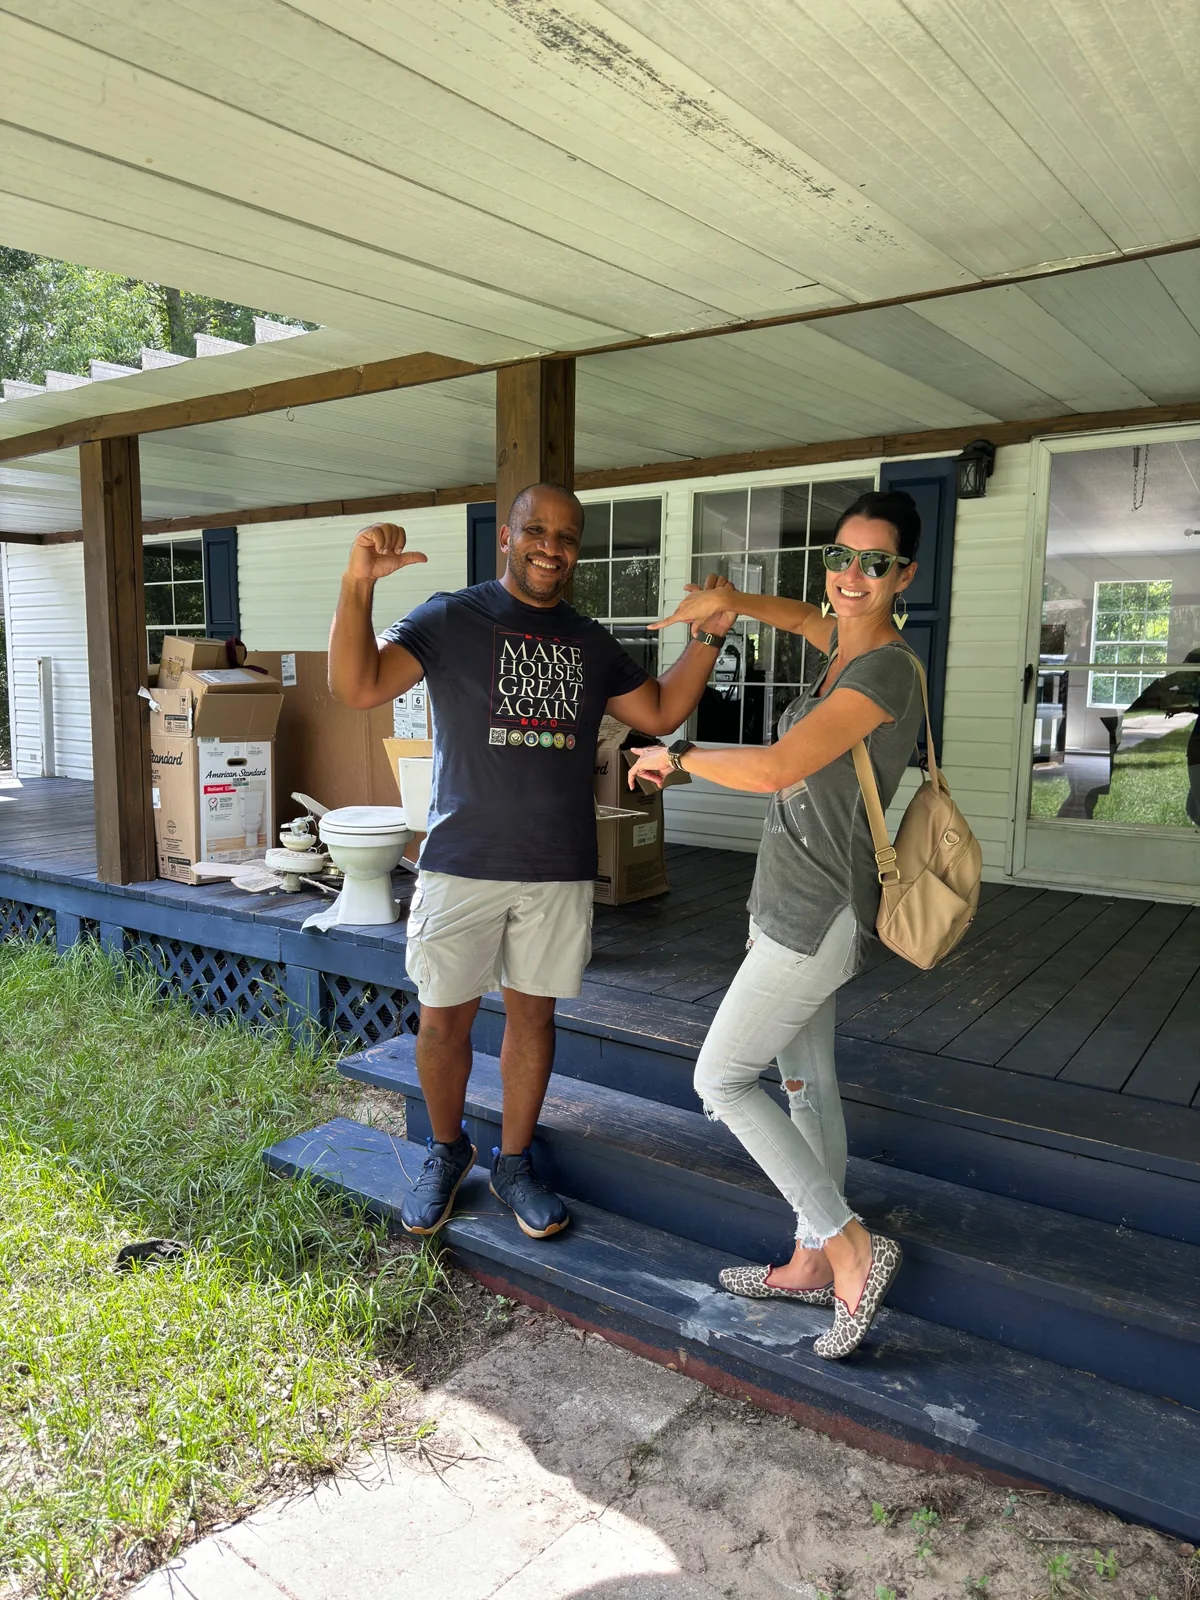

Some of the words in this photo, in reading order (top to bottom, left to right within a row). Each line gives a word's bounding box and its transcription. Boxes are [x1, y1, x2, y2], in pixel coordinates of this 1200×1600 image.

[500, 639, 583, 667] MAKE
[499, 658, 584, 683] HOUSES
[498, 676, 584, 701] GREAT
[495, 696, 579, 721] AGAIN
[205, 770, 237, 779] American
[239, 768, 267, 777] Standard
